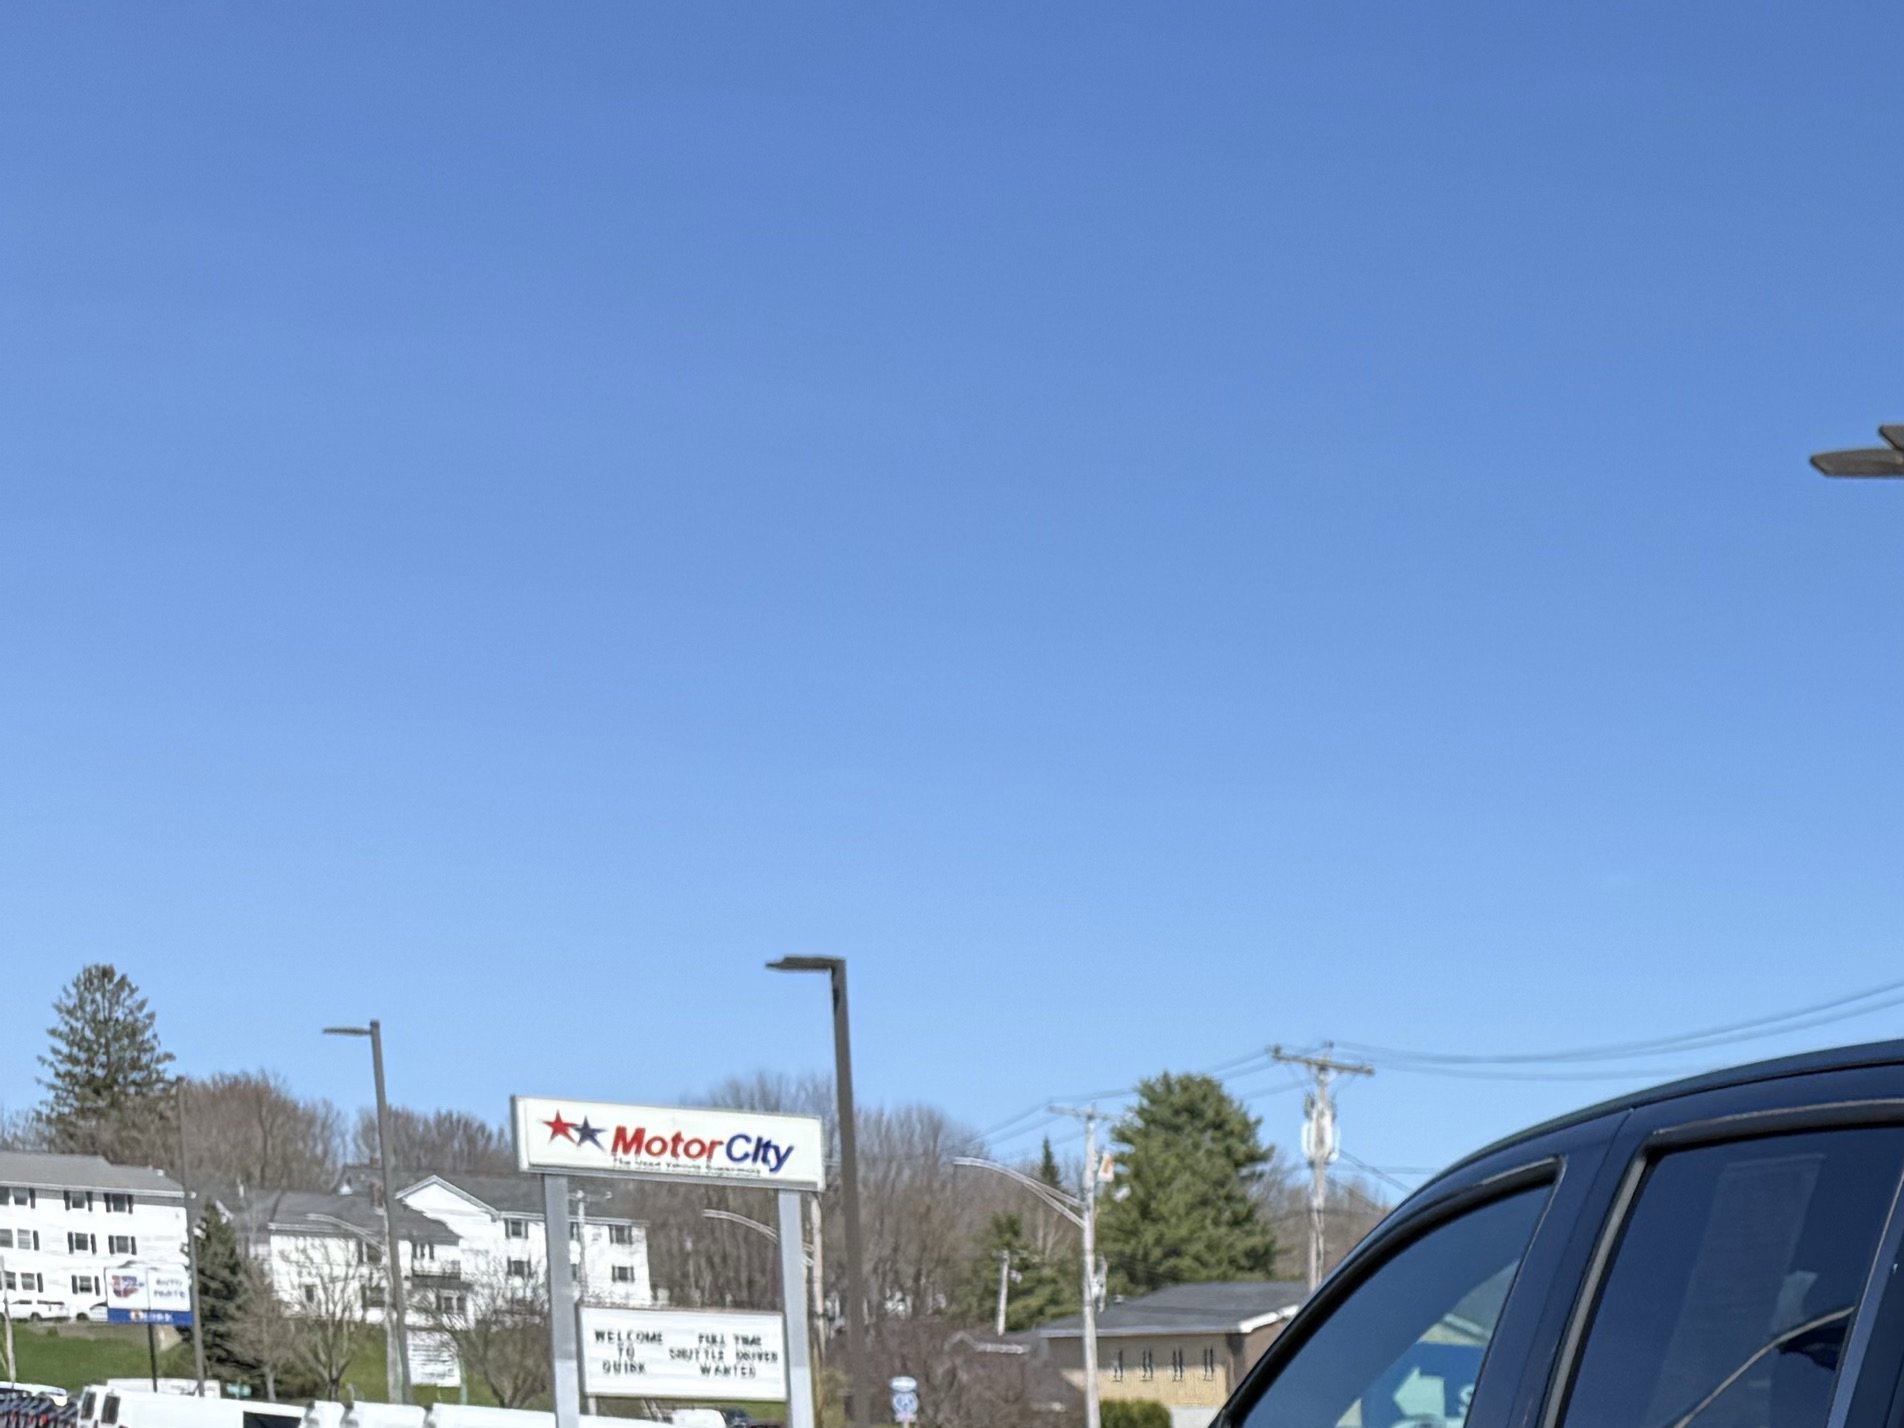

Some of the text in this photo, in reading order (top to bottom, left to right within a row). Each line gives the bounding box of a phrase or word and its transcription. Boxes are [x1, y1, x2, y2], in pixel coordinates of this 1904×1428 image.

[611, 1125, 794, 1173] MotorCity
[594, 1328, 664, 1345] WELCOME
[697, 1332, 762, 1346] FULL TIME
[617, 1343, 635, 1361] TO
[669, 1347, 779, 1364] SHUTTLE DRIVER
[602, 1359, 647, 1375] QUIRK
[700, 1364, 757, 1379] WANTED
